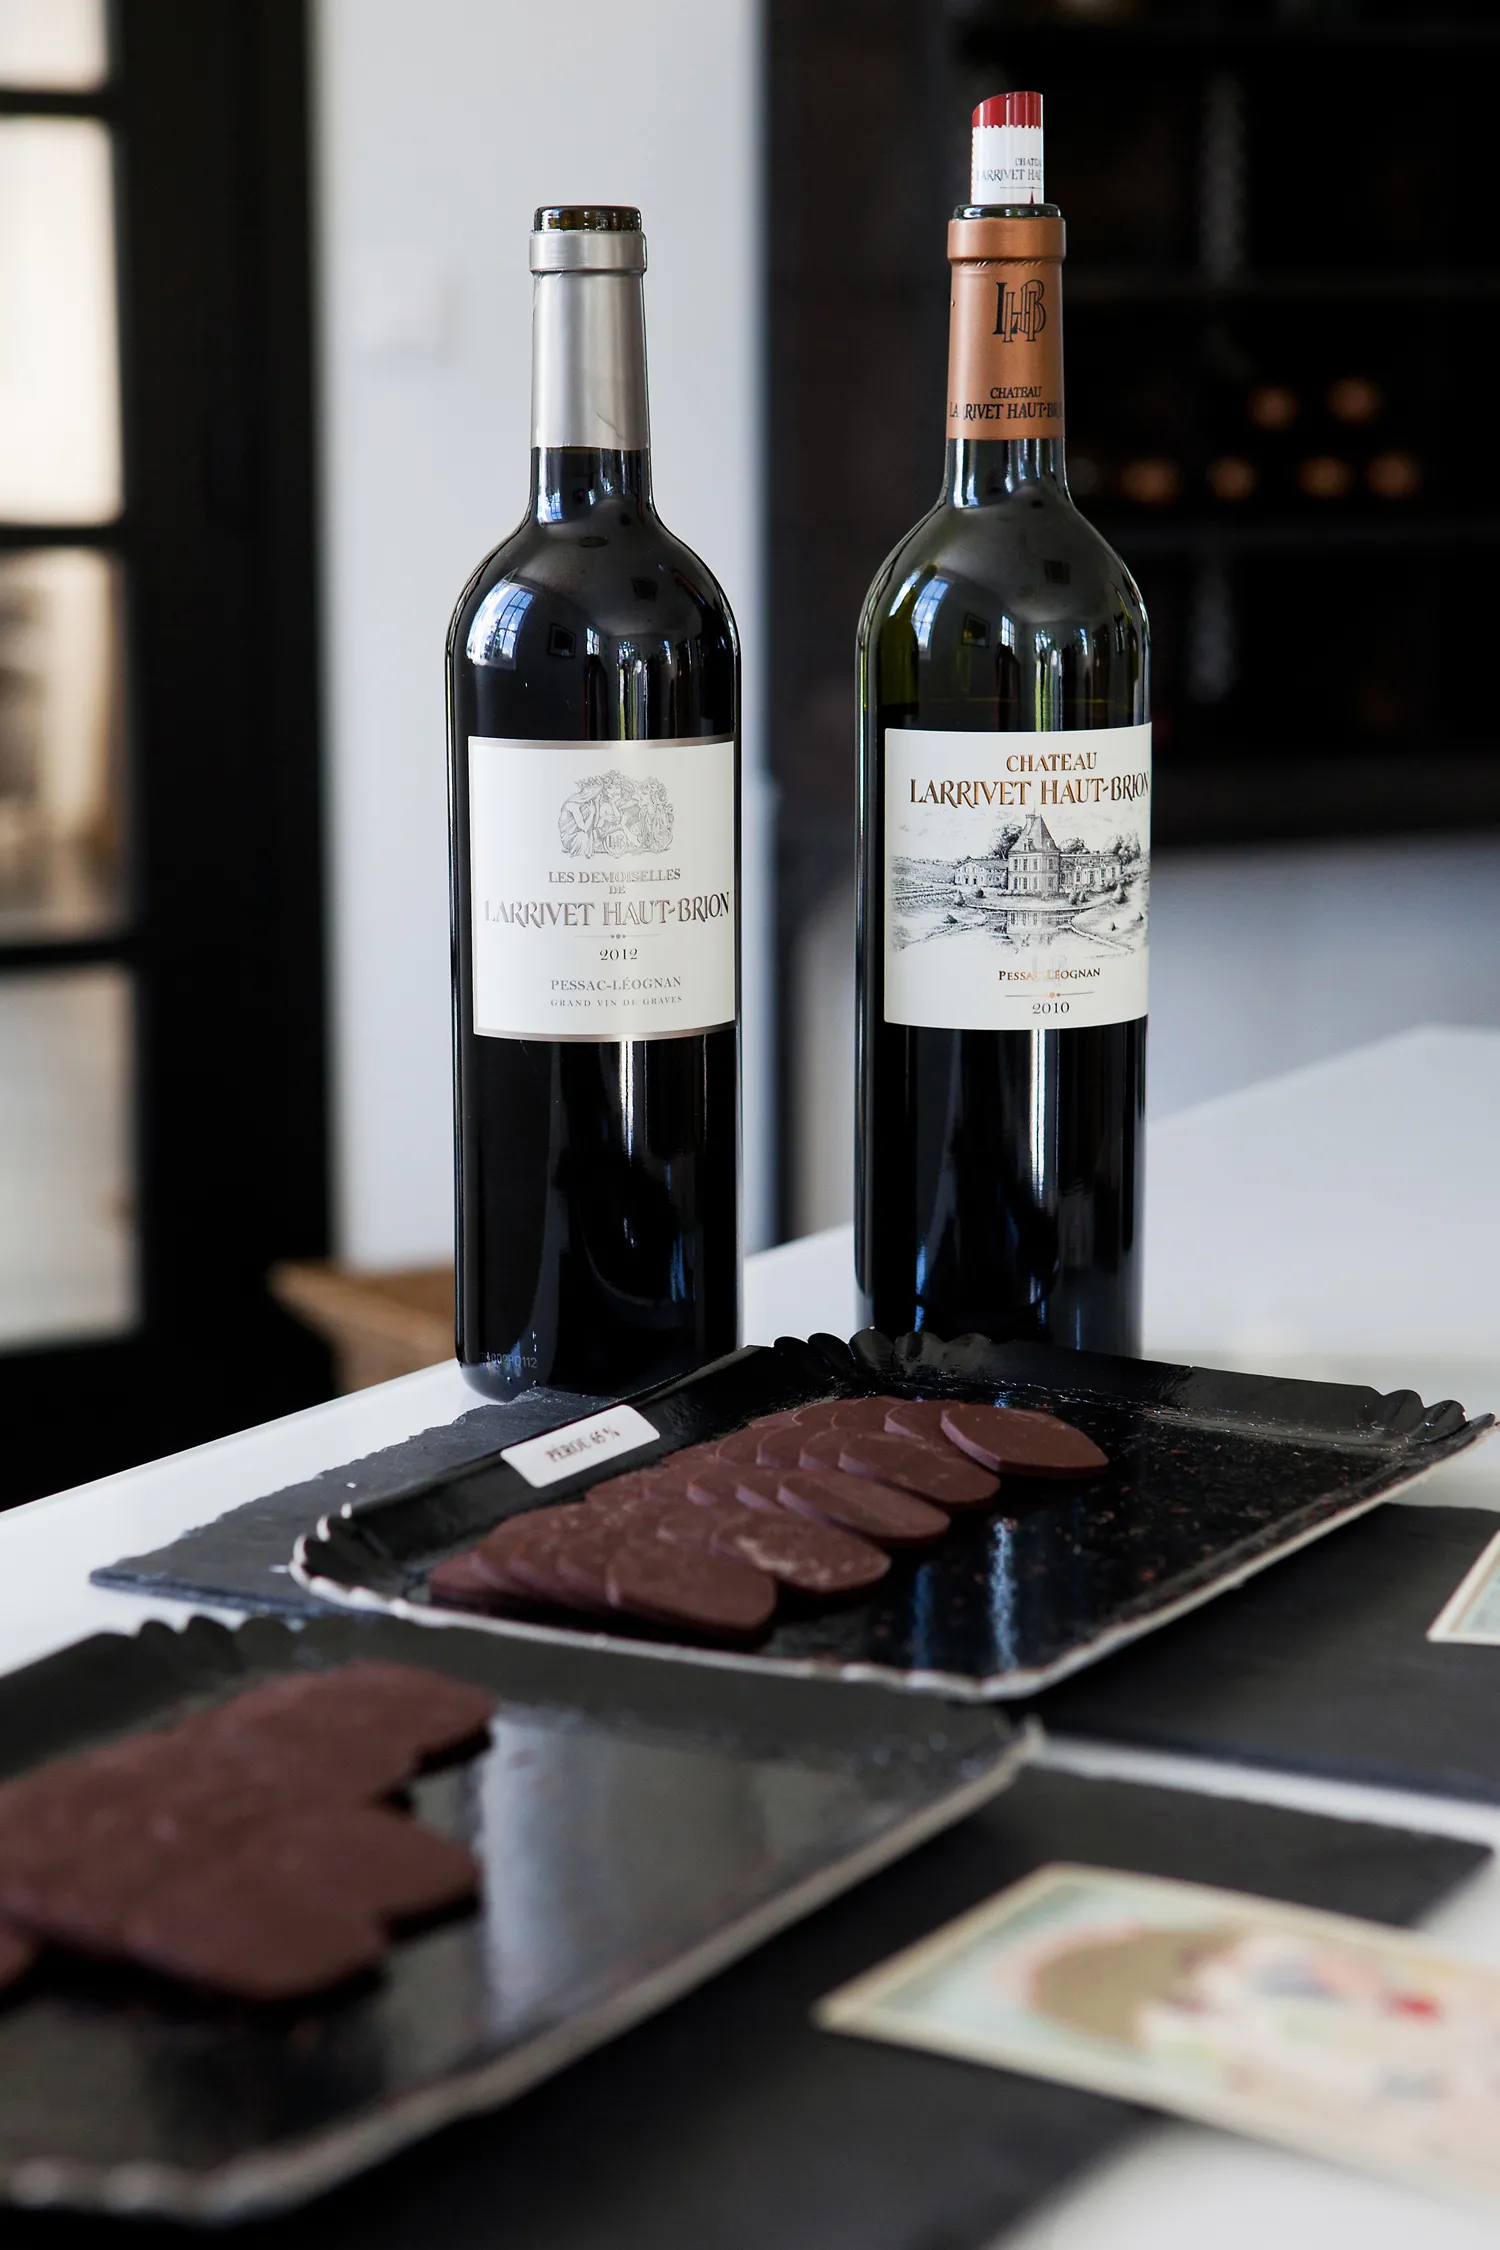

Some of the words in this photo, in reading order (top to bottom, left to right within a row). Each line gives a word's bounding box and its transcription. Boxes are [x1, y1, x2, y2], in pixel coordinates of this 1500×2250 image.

[990, 386, 1042, 399] CHATEAU
[949, 402, 1004, 421] LARIVET
[1006, 752, 1098, 773] CHATEAU
[910, 778, 1032, 809] LARRIVET
[1040, 771, 1149, 805] HAUT-BRION
[548, 871, 575, 883] LES
[578, 868, 681, 883] DEMOISELLES
[608, 885, 626, 895] DE
[484, 901, 595, 929] LARRIVET
[603, 892, 730, 926] HAUT-BRION
[599, 948, 638, 961] 2012
[550, 976, 682, 991] PESSAC-LÉOGNAN
[550, 998, 591, 1007] GRAND
[597, 998, 618, 1007] VIN
[623, 998, 637, 1006] DE
[642, 995, 683, 1006] GRAVES
[1032, 1001, 1070, 1015] 2010
